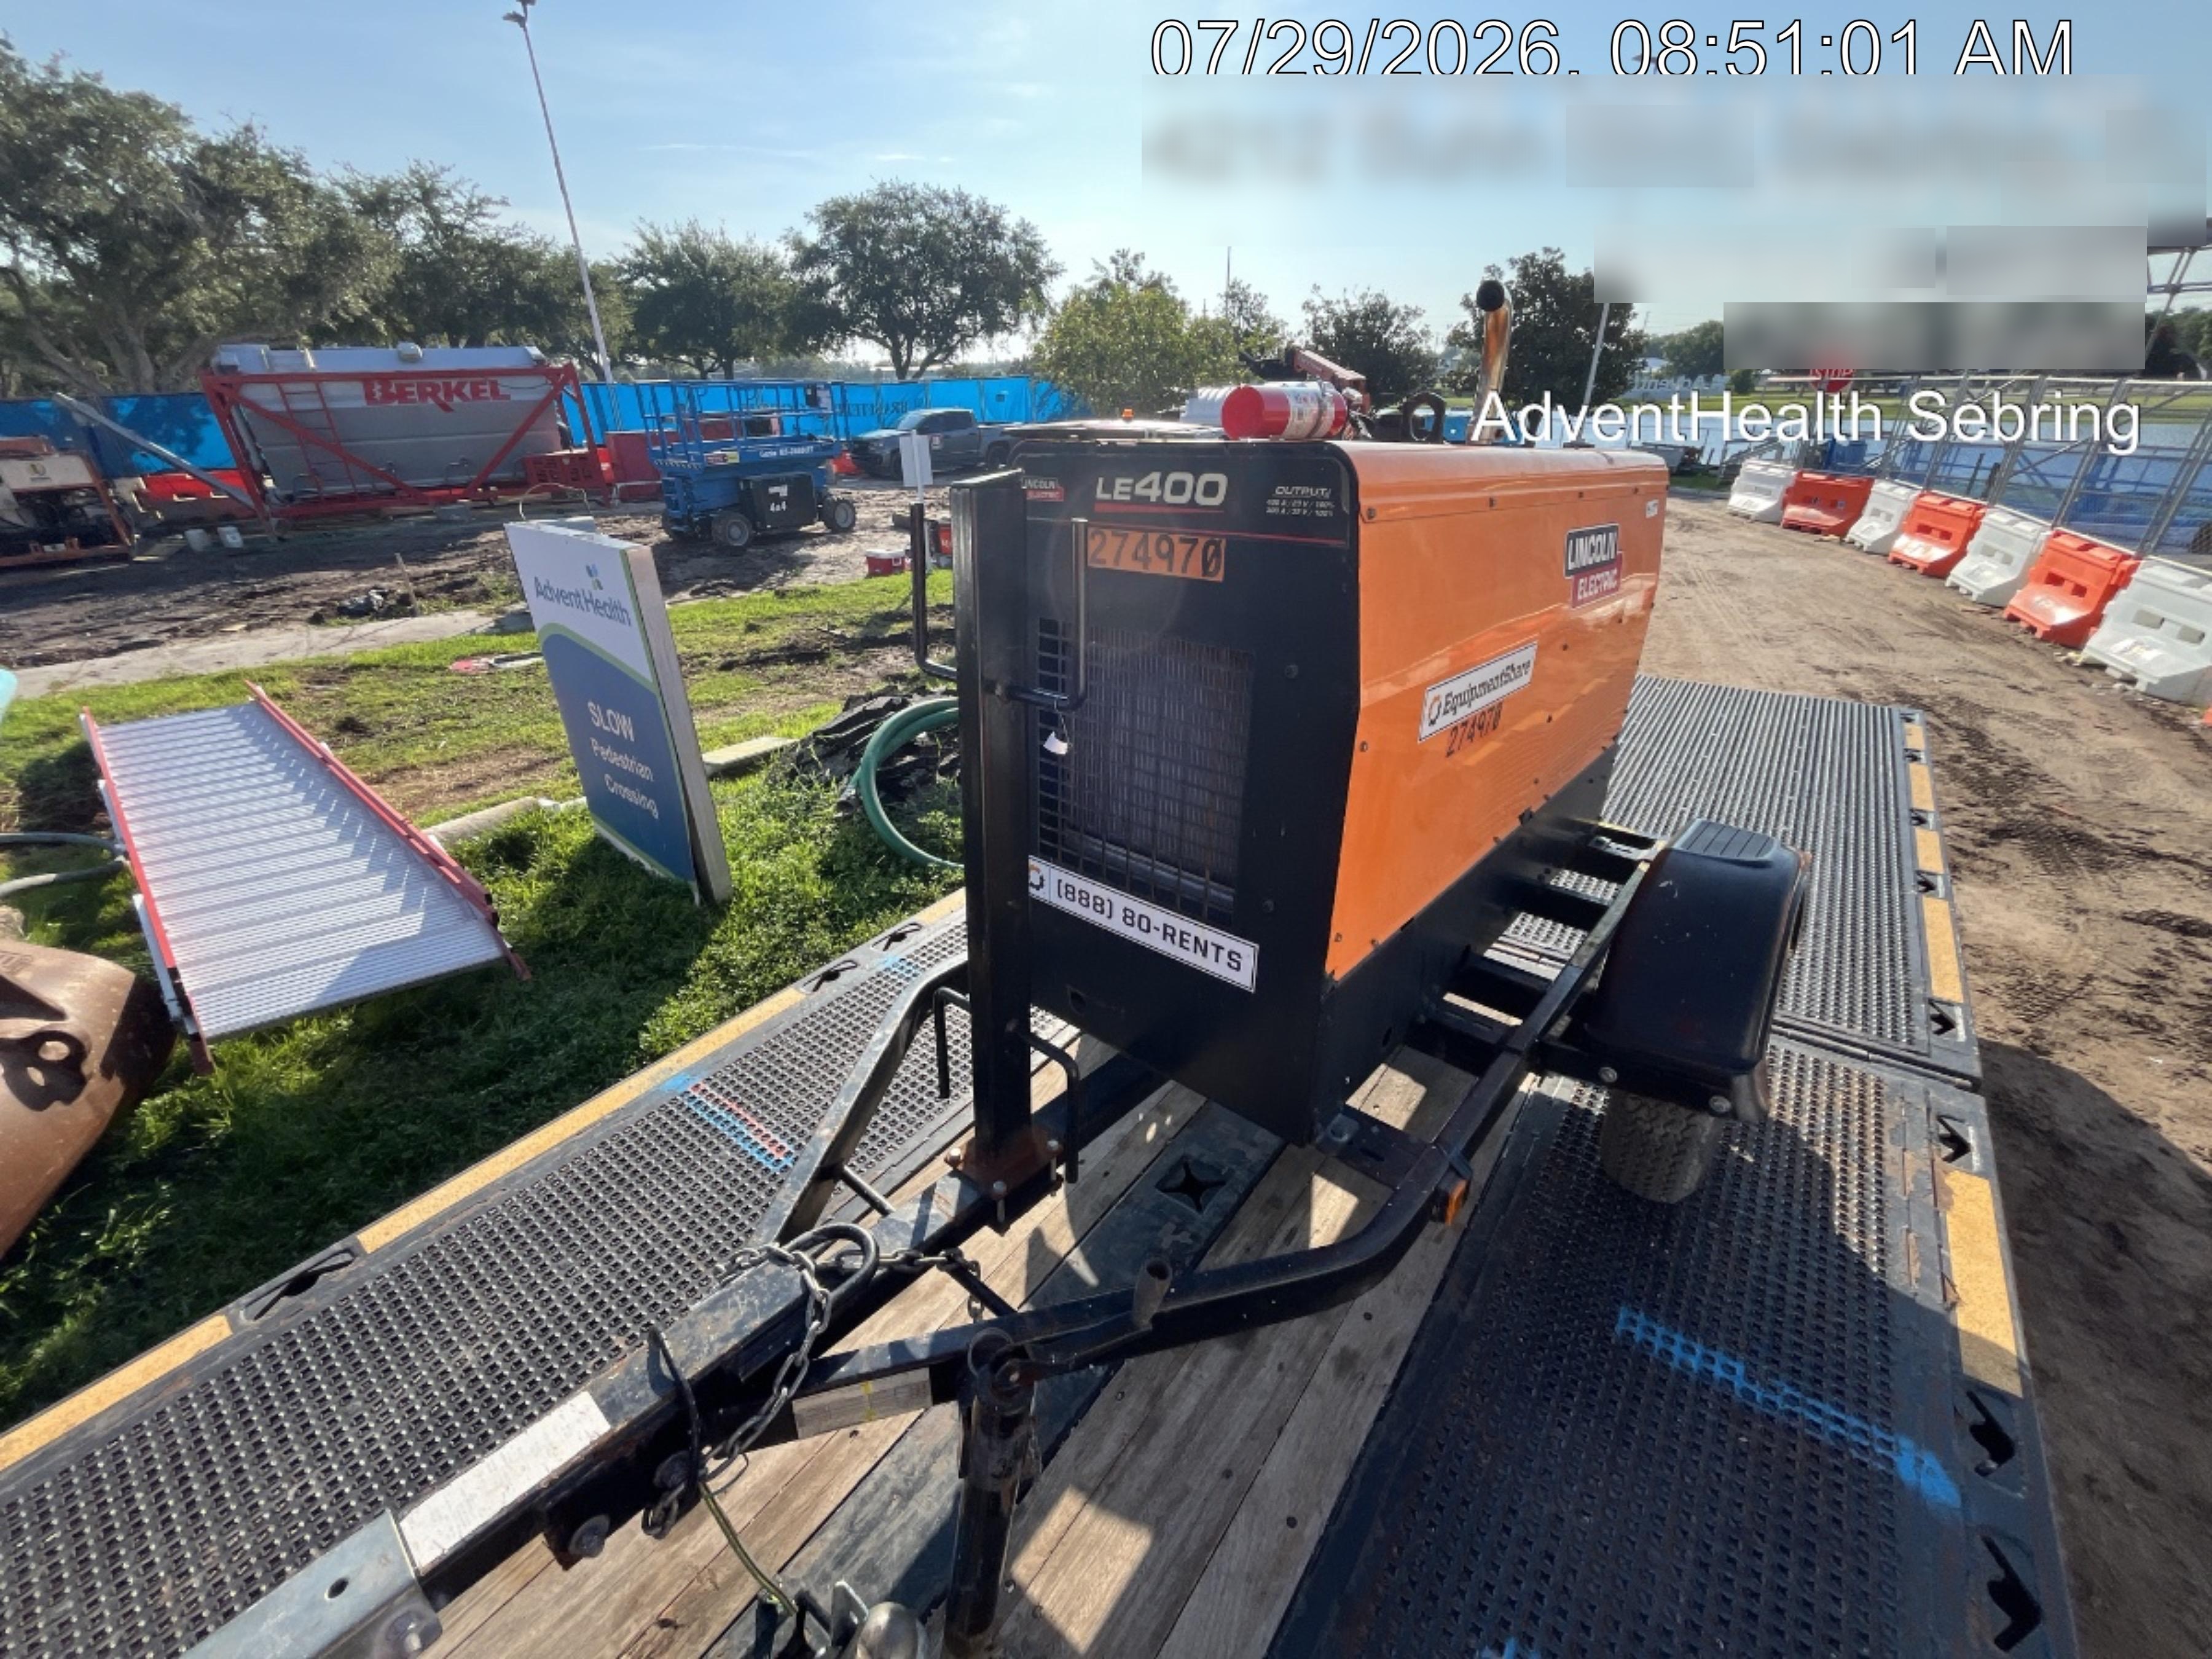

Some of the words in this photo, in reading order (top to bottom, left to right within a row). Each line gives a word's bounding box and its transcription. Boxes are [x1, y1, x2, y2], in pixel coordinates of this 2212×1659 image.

[363, 379, 511, 412] BERKEL
[1096, 472, 1228, 506] LE400
[1275, 485, 1328, 496] OUTPUT
[1568, 532, 1617, 570] LINCOLN
[534, 576, 632, 626] AdventHealth
[1577, 567, 1617, 600] ELECTRIC
[1443, 659, 1531, 715] EquipmentShare
[587, 700, 634, 742] SLOW
[590, 737, 654, 782] Pedestrian
[603, 773, 659, 820] Crossing
[1122, 906, 1242, 972] 80-RENTS
